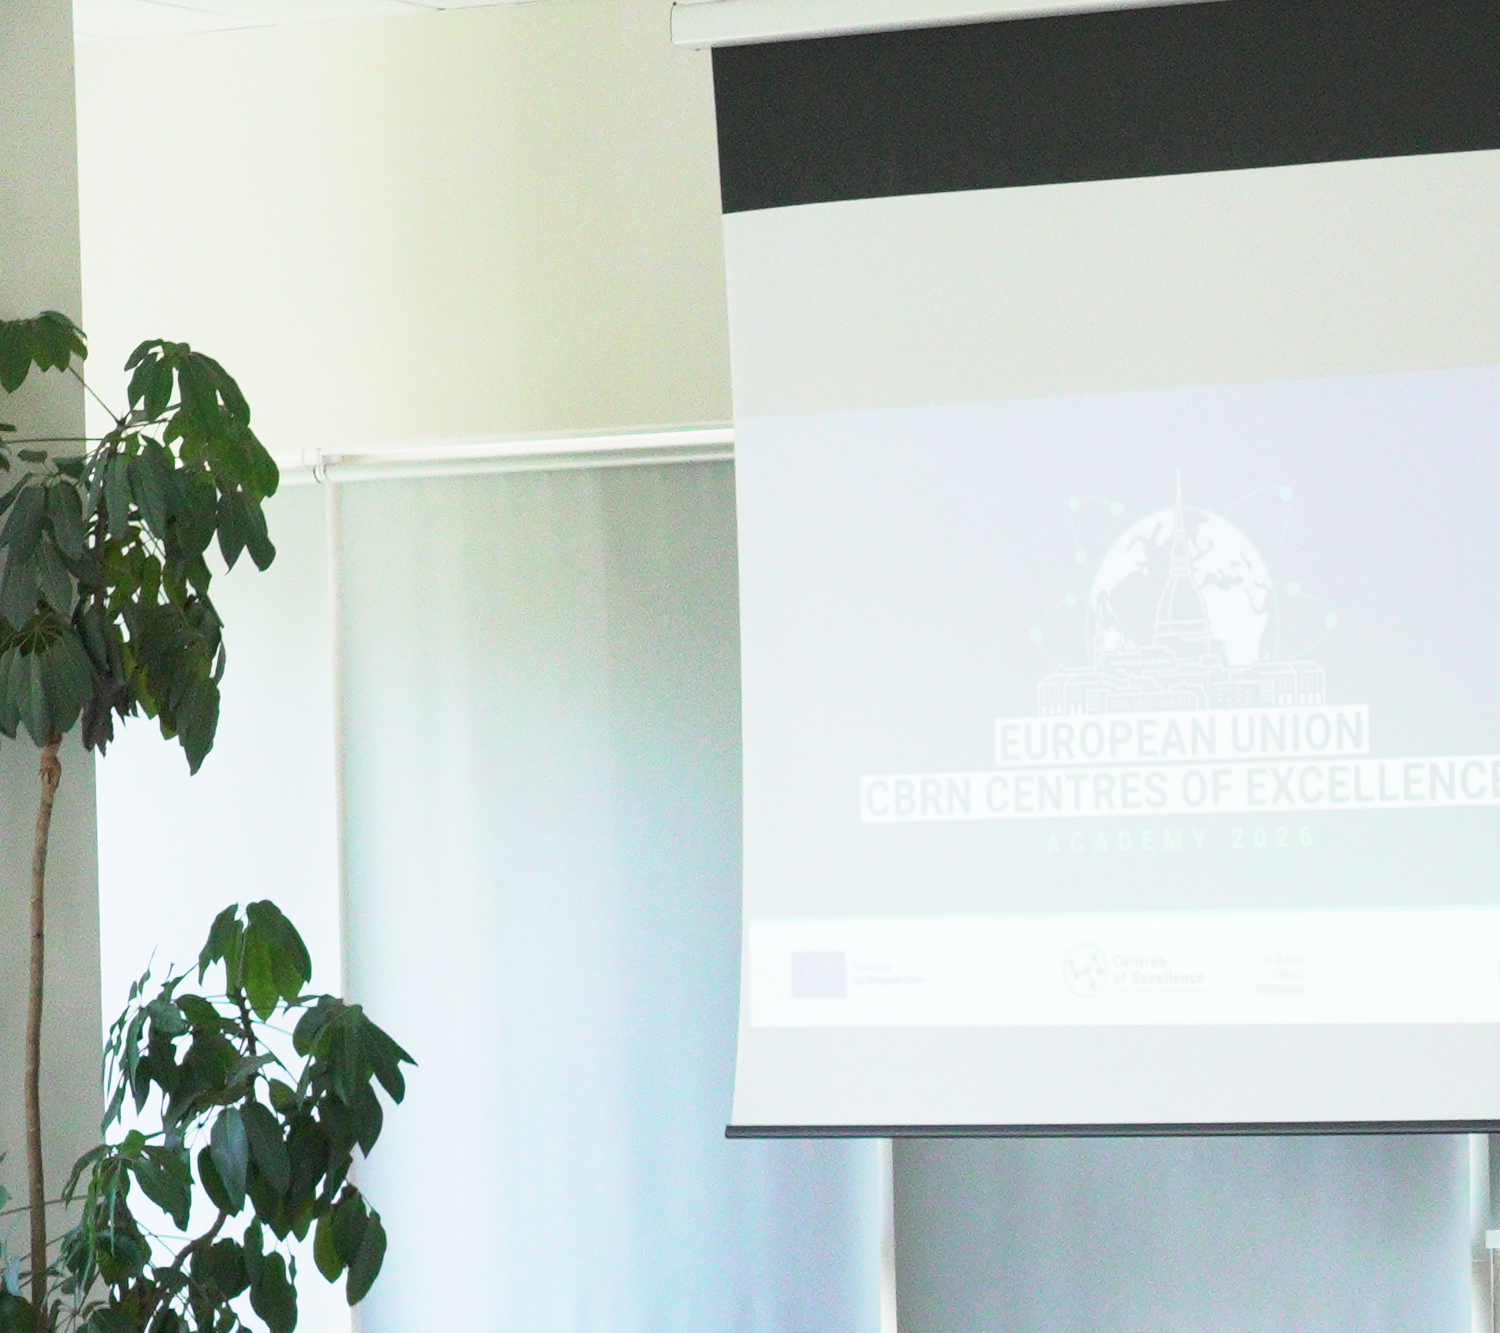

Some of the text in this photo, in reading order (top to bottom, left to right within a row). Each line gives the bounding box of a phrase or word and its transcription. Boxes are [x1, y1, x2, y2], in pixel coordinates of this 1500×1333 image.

[1001, 711, 1363, 762] EUROPEAN UNION
[866, 777, 972, 817] CBRN
[985, 771, 1168, 814] CENTRES
[1181, 768, 1232, 808] OF
[1046, 826, 1312, 852] ACADEMY 2026
[1113, 954, 1166, 968] Centres
[1132, 970, 1206, 984] Excellence
